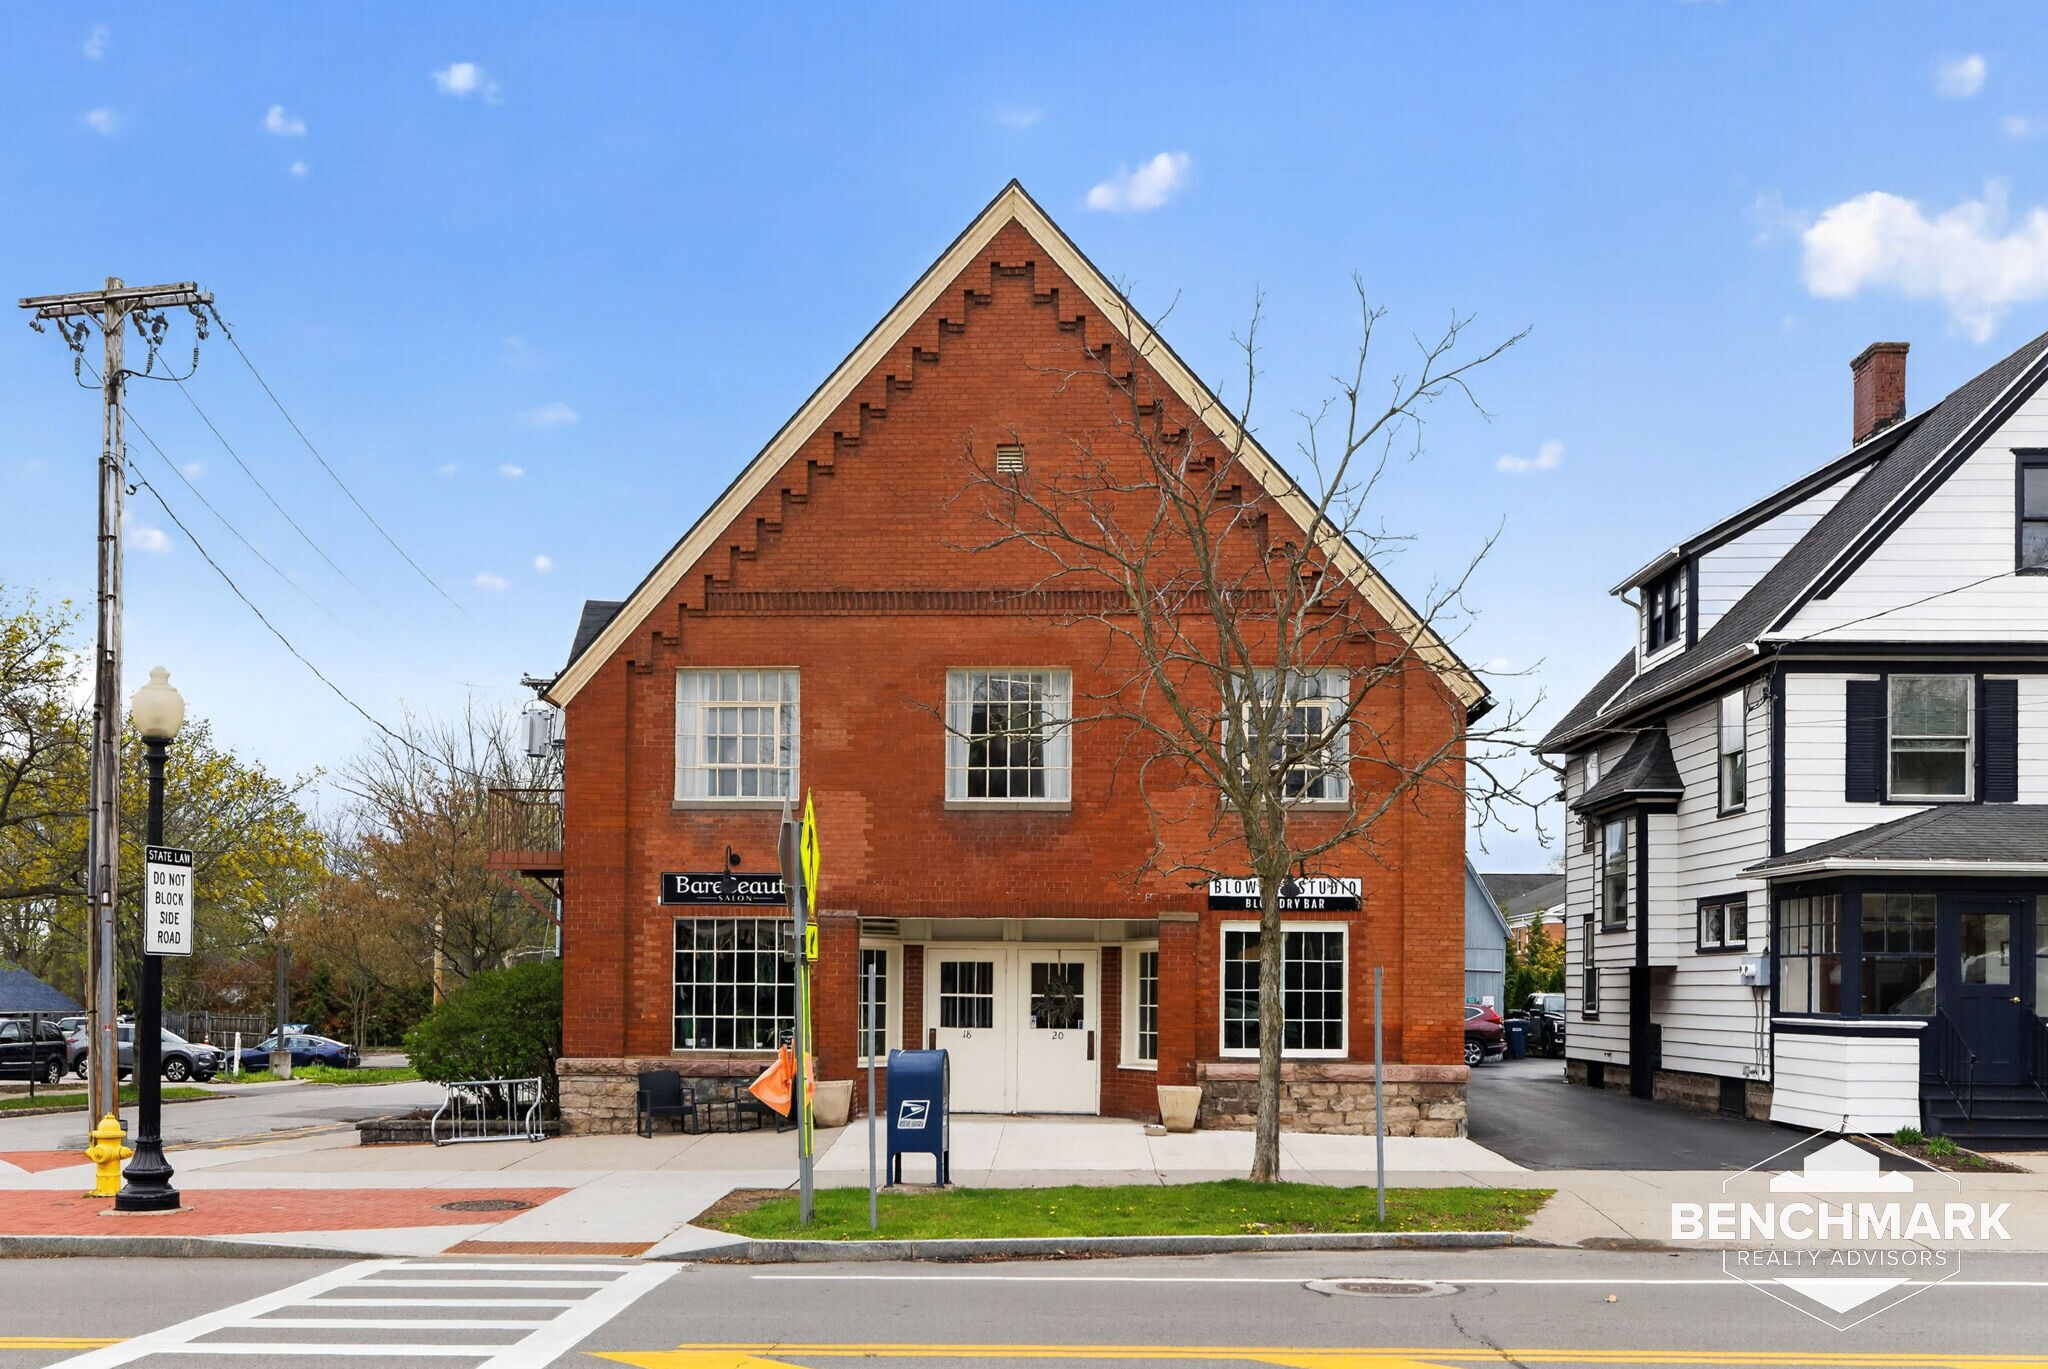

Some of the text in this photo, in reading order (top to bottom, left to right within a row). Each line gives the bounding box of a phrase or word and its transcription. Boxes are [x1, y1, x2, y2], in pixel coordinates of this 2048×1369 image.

[148, 849, 190, 864] STATE LAW
[153, 871, 186, 887] DO NOT
[155, 891, 184, 906] BLOCK
[1279, 898, 1300, 909] DRY
[1303, 898, 1325, 909] BAR
[159, 911, 180, 925] SIDE
[157, 930, 181, 945] ROAD
[963, 1029, 972, 1039] 18
[1051, 1031, 1064, 1040] 20
